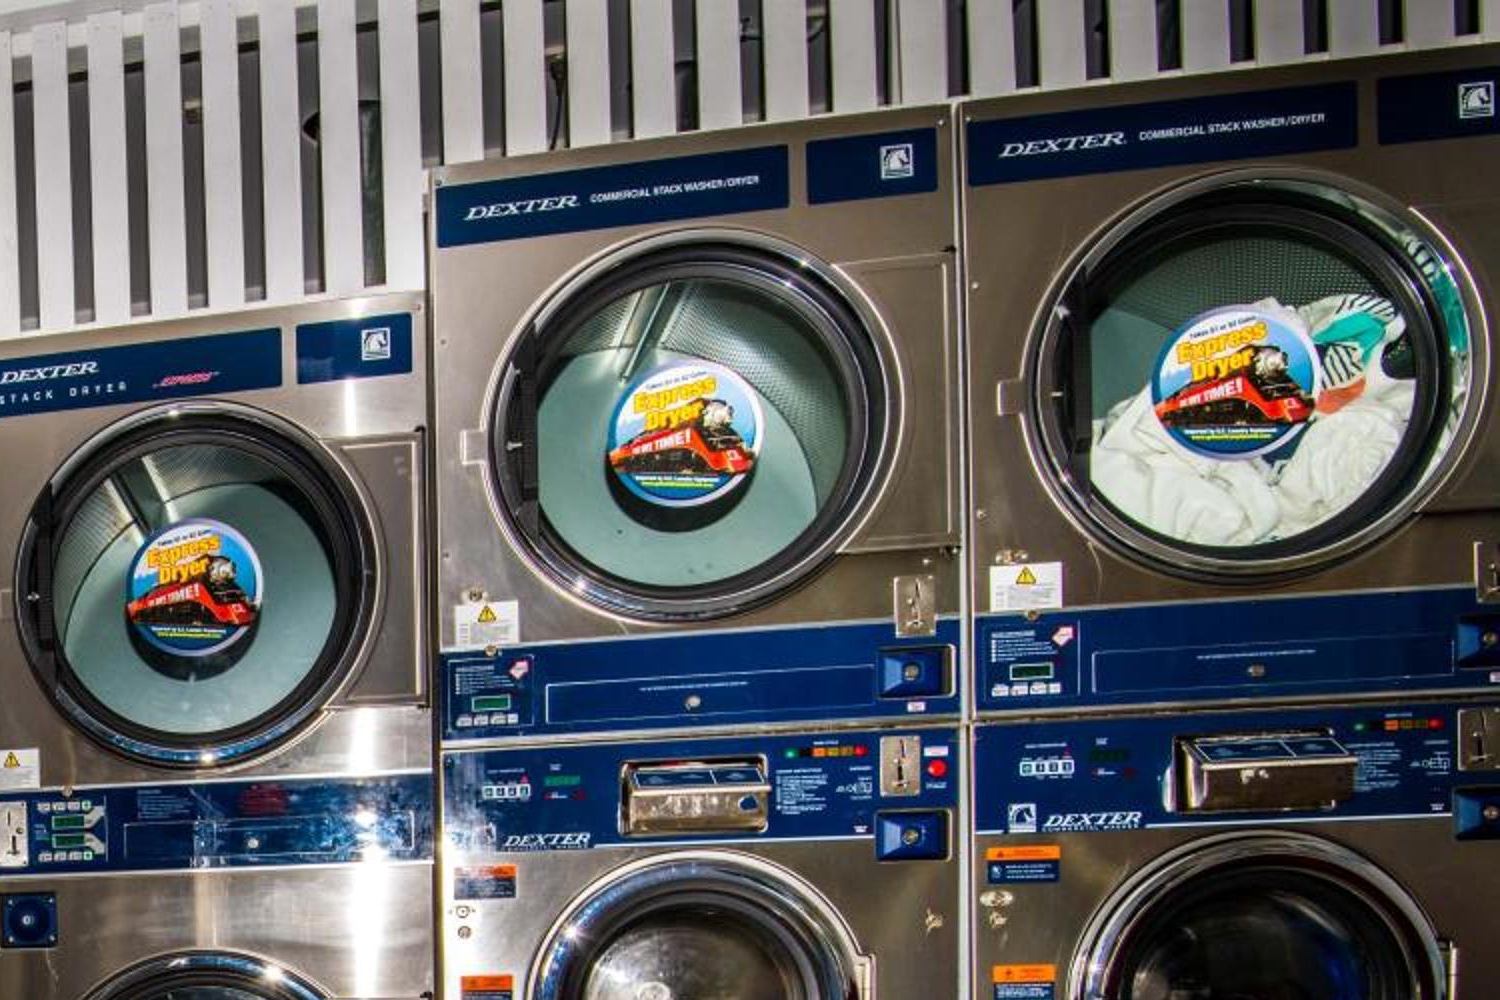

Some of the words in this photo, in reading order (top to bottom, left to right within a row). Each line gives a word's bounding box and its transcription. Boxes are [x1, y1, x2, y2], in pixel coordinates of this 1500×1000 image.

[999, 131, 1127, 158] DEXTER
[1139, 124, 1205, 142] COMMERCIAL
[1207, 120, 1241, 135] STACK
[1242, 113, 1325, 130] WASHER/DRYER
[464, 195, 580, 221] DEXTER
[589, 187, 650, 204] COMMERCIAL
[653, 183, 683, 196] STACK
[1177, 320, 1267, 364] Express
[1191, 348, 1253, 381] Dryer
[70, 381, 127, 397] DRYER
[634, 376, 717, 413] Express
[645, 401, 704, 431] Dryer
[147, 535, 221, 568] Express
[158, 556, 211, 586] Dryer
[1044, 811, 1142, 827] DEXTER
[504, 832, 591, 848] DEXTER
